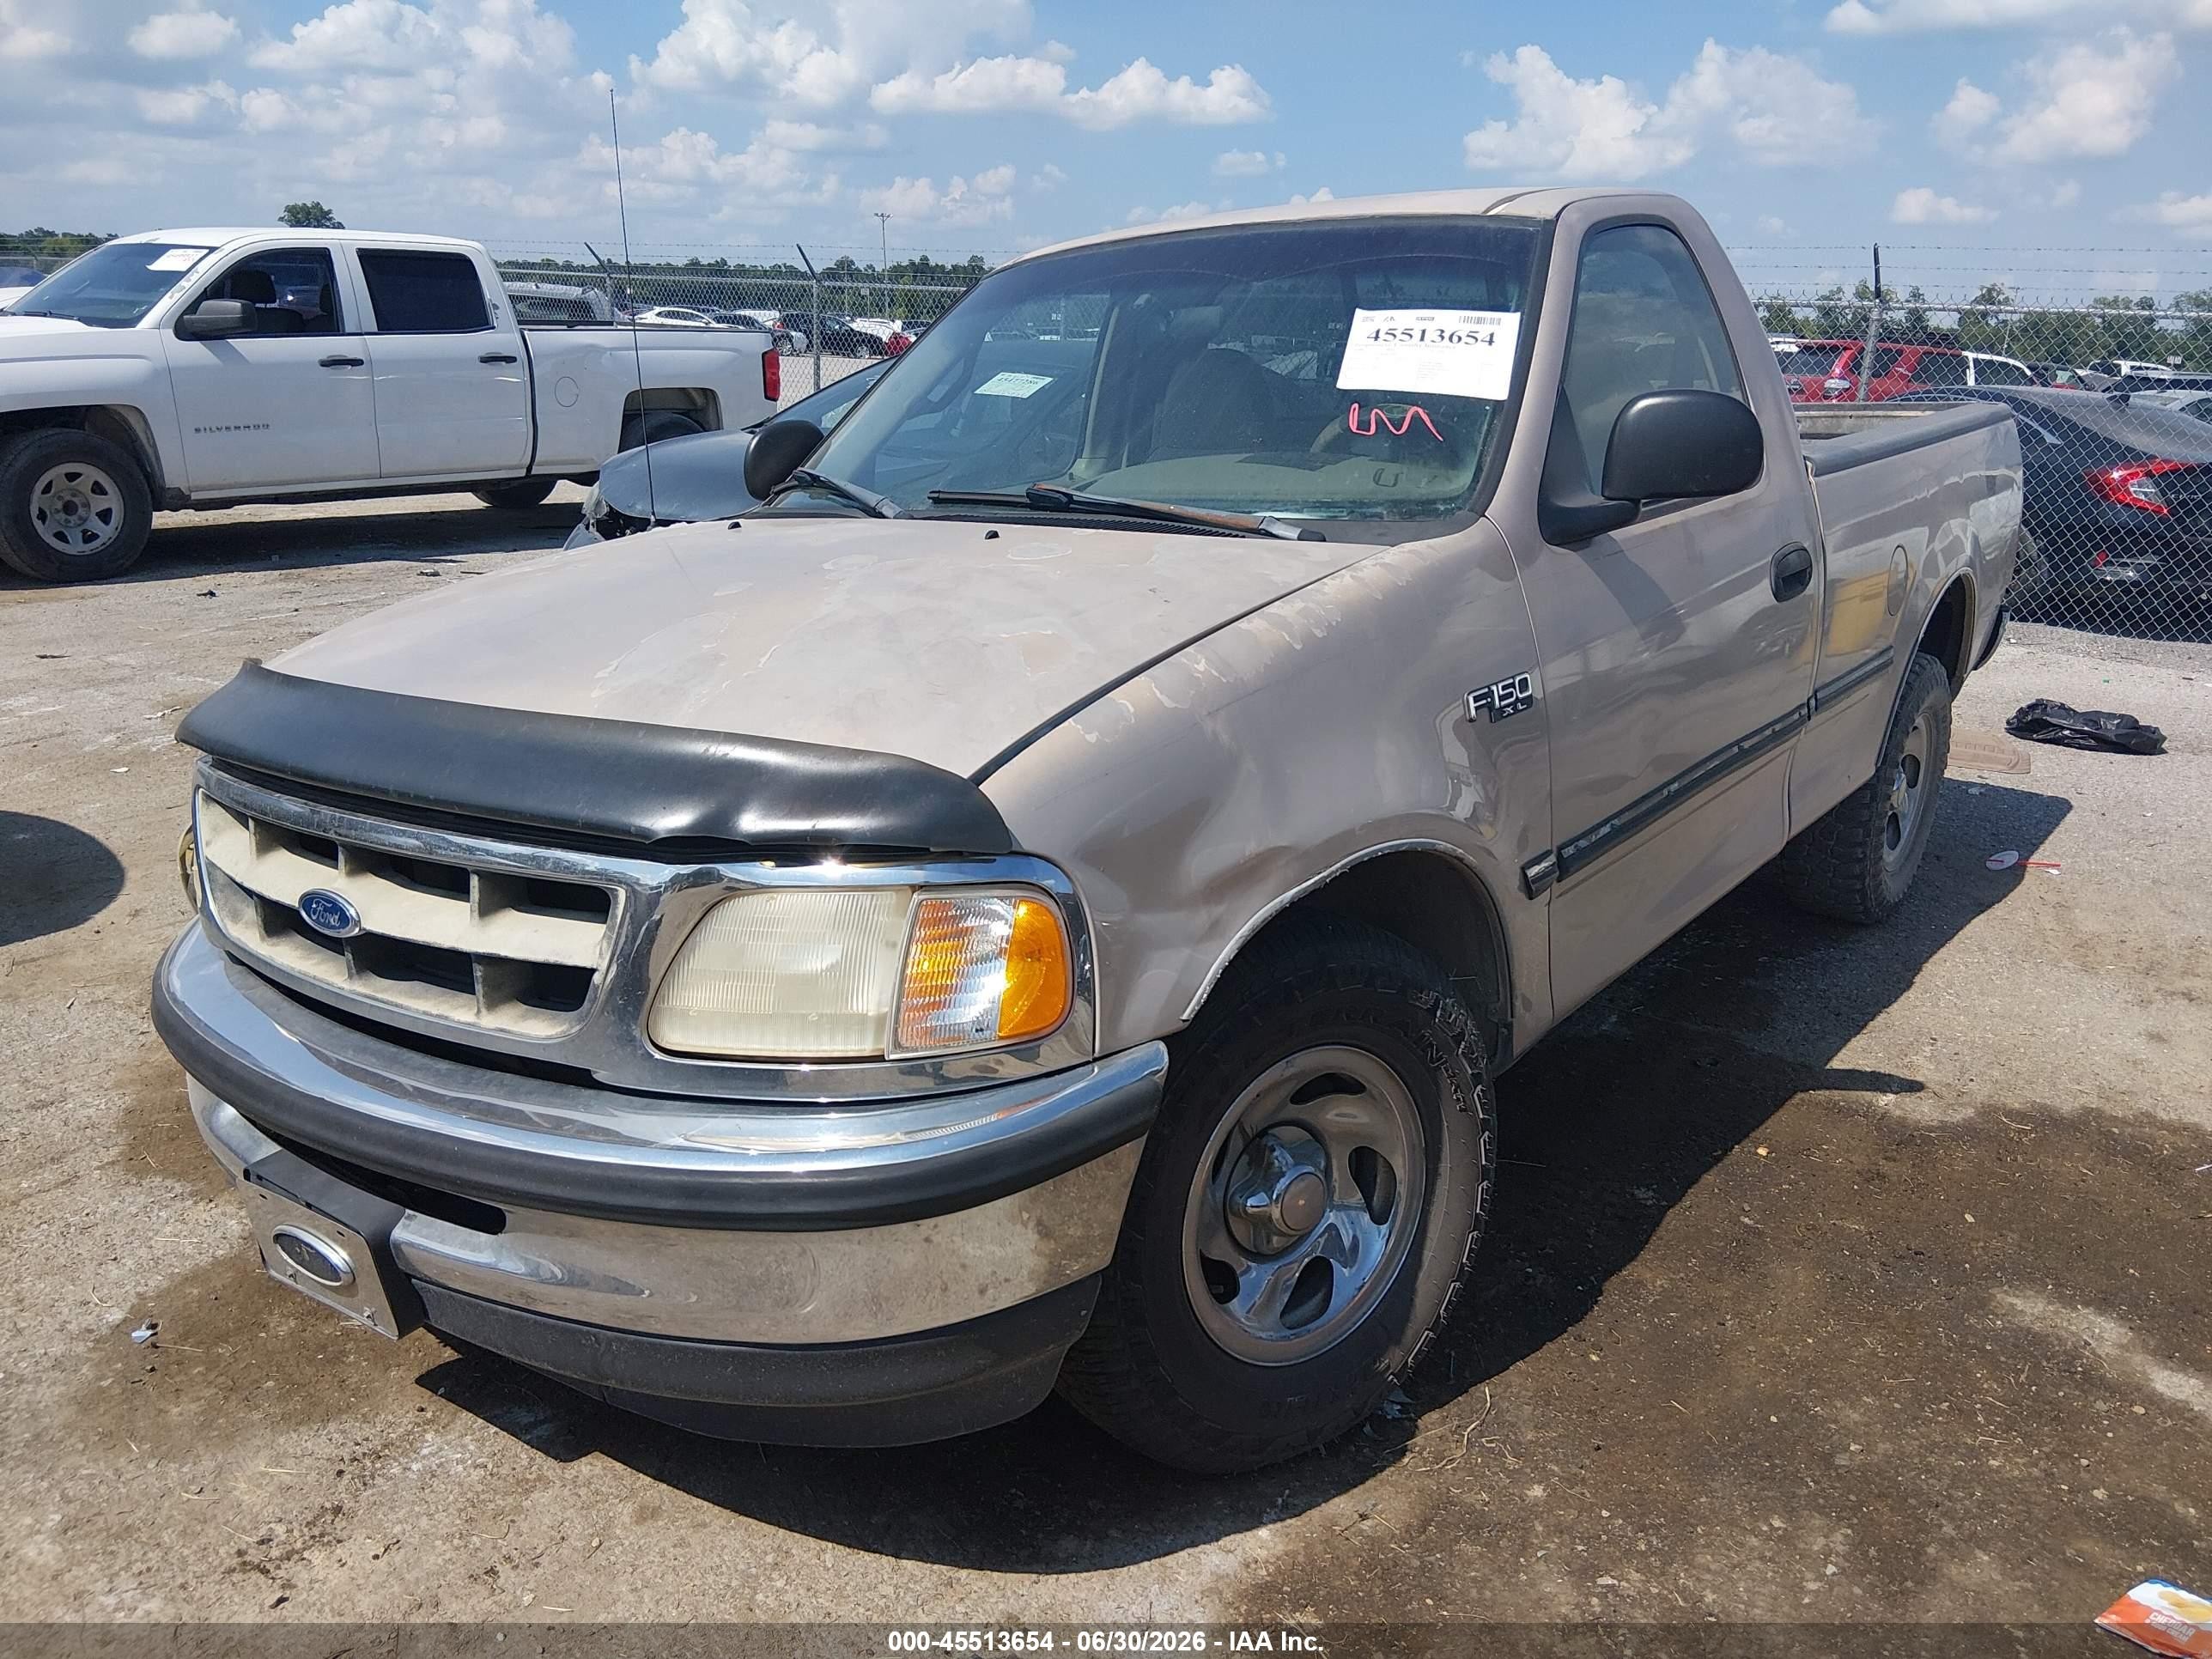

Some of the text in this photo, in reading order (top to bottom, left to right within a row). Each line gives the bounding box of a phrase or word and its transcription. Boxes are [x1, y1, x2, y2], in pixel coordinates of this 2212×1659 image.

[1366, 328, 1496, 347] 45513654
[194, 423, 270, 434] SILVERADO
[1502, 702, 1528, 717] XL
[310, 898, 341, 927] Ford
[2148, 1612, 2196, 1638] CHEDDAR
